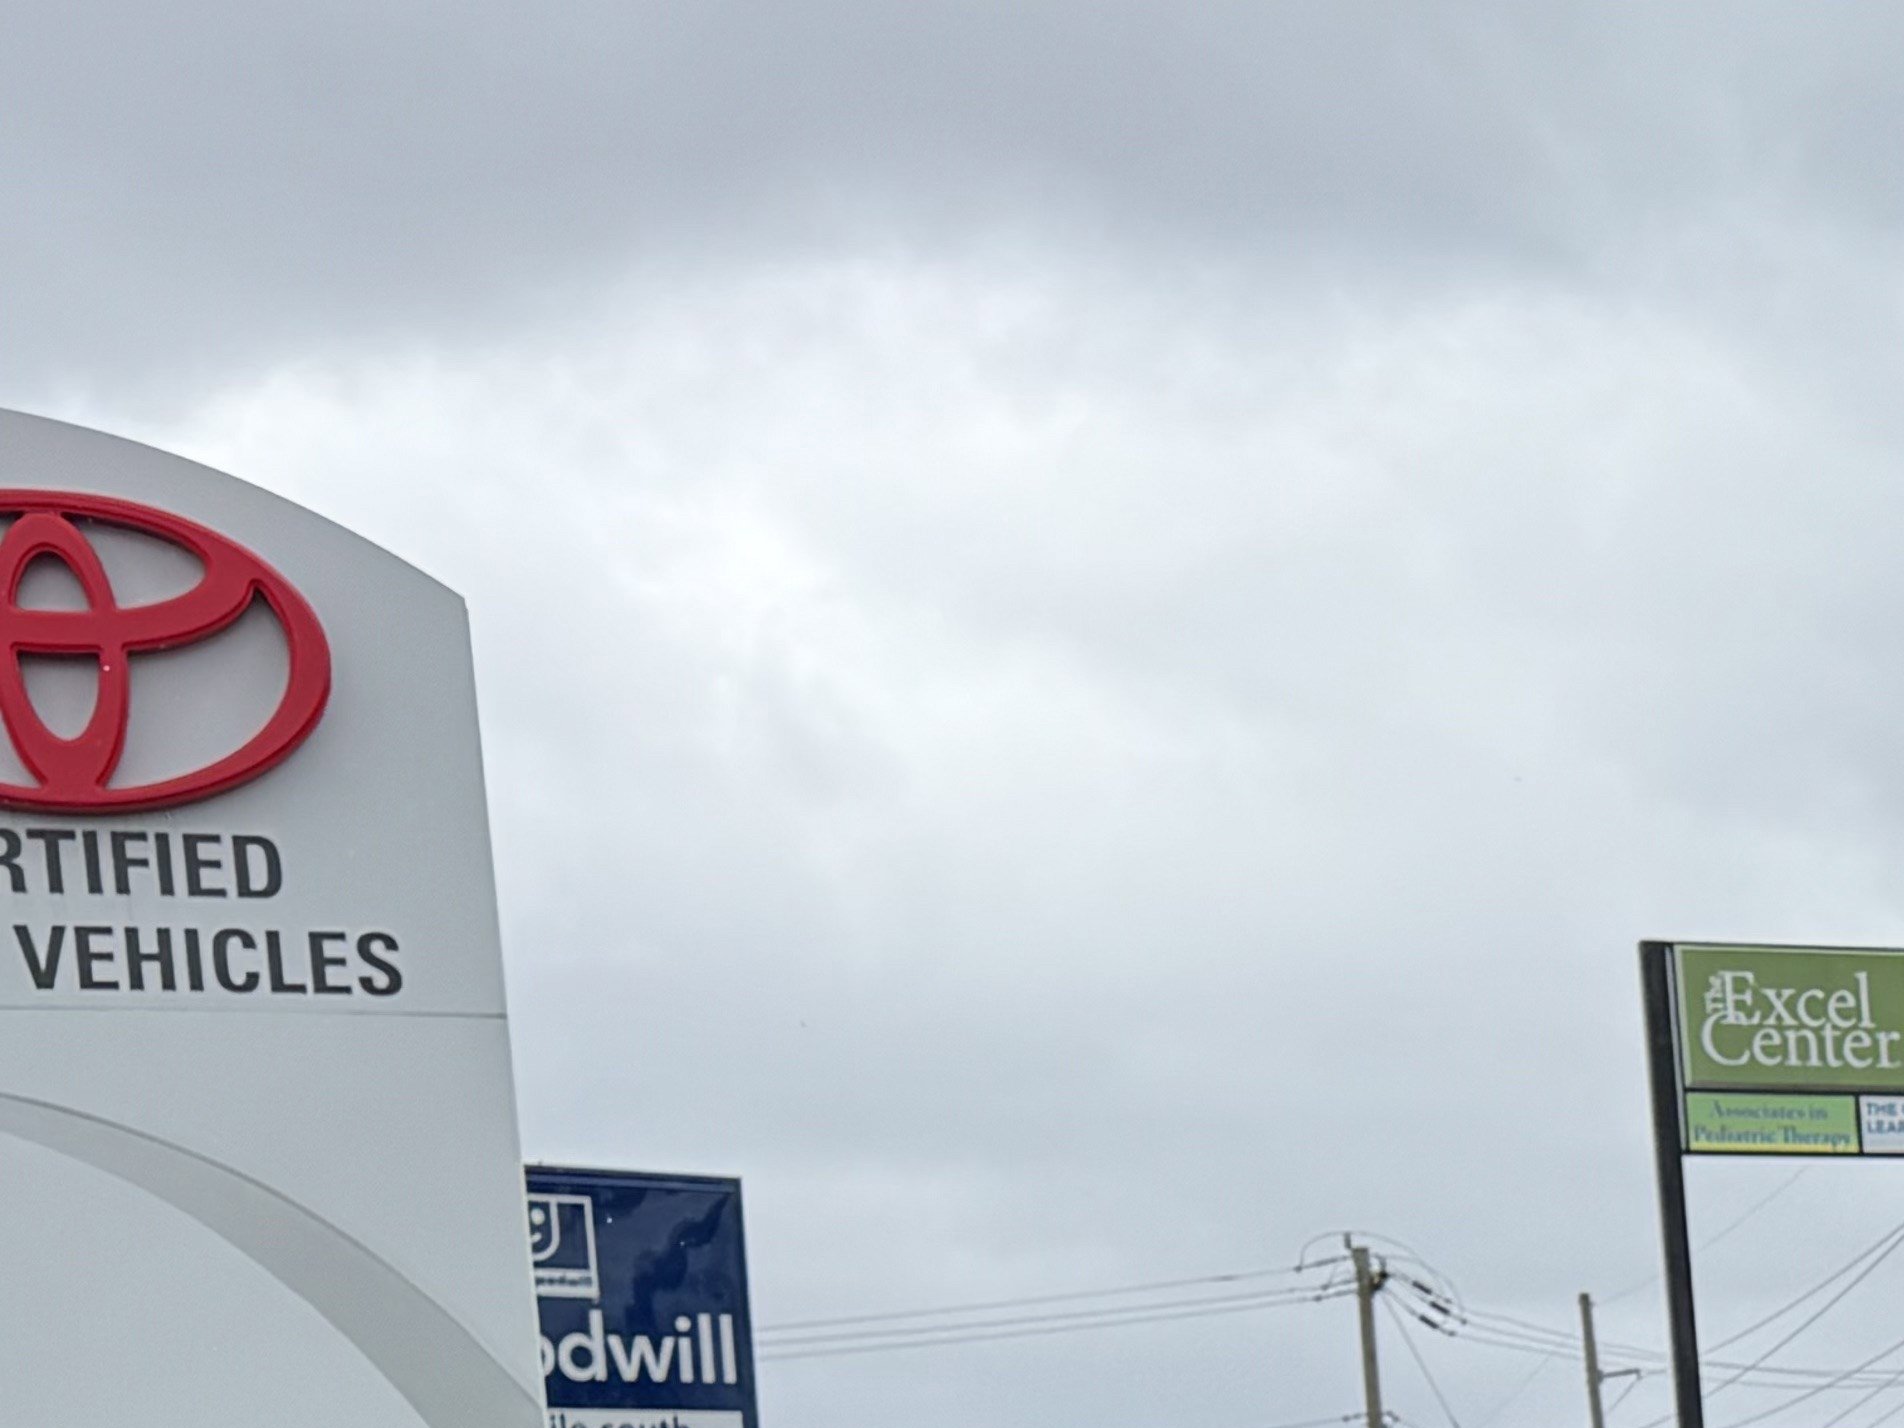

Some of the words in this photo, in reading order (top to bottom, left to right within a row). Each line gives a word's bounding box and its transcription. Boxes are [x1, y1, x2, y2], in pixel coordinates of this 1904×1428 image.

[13, 924, 403, 996] VEHICLES
[1718, 970, 1876, 1028] Excel
[1701, 1010, 1902, 1069] Center
[1866, 1102, 1898, 1116] THE
